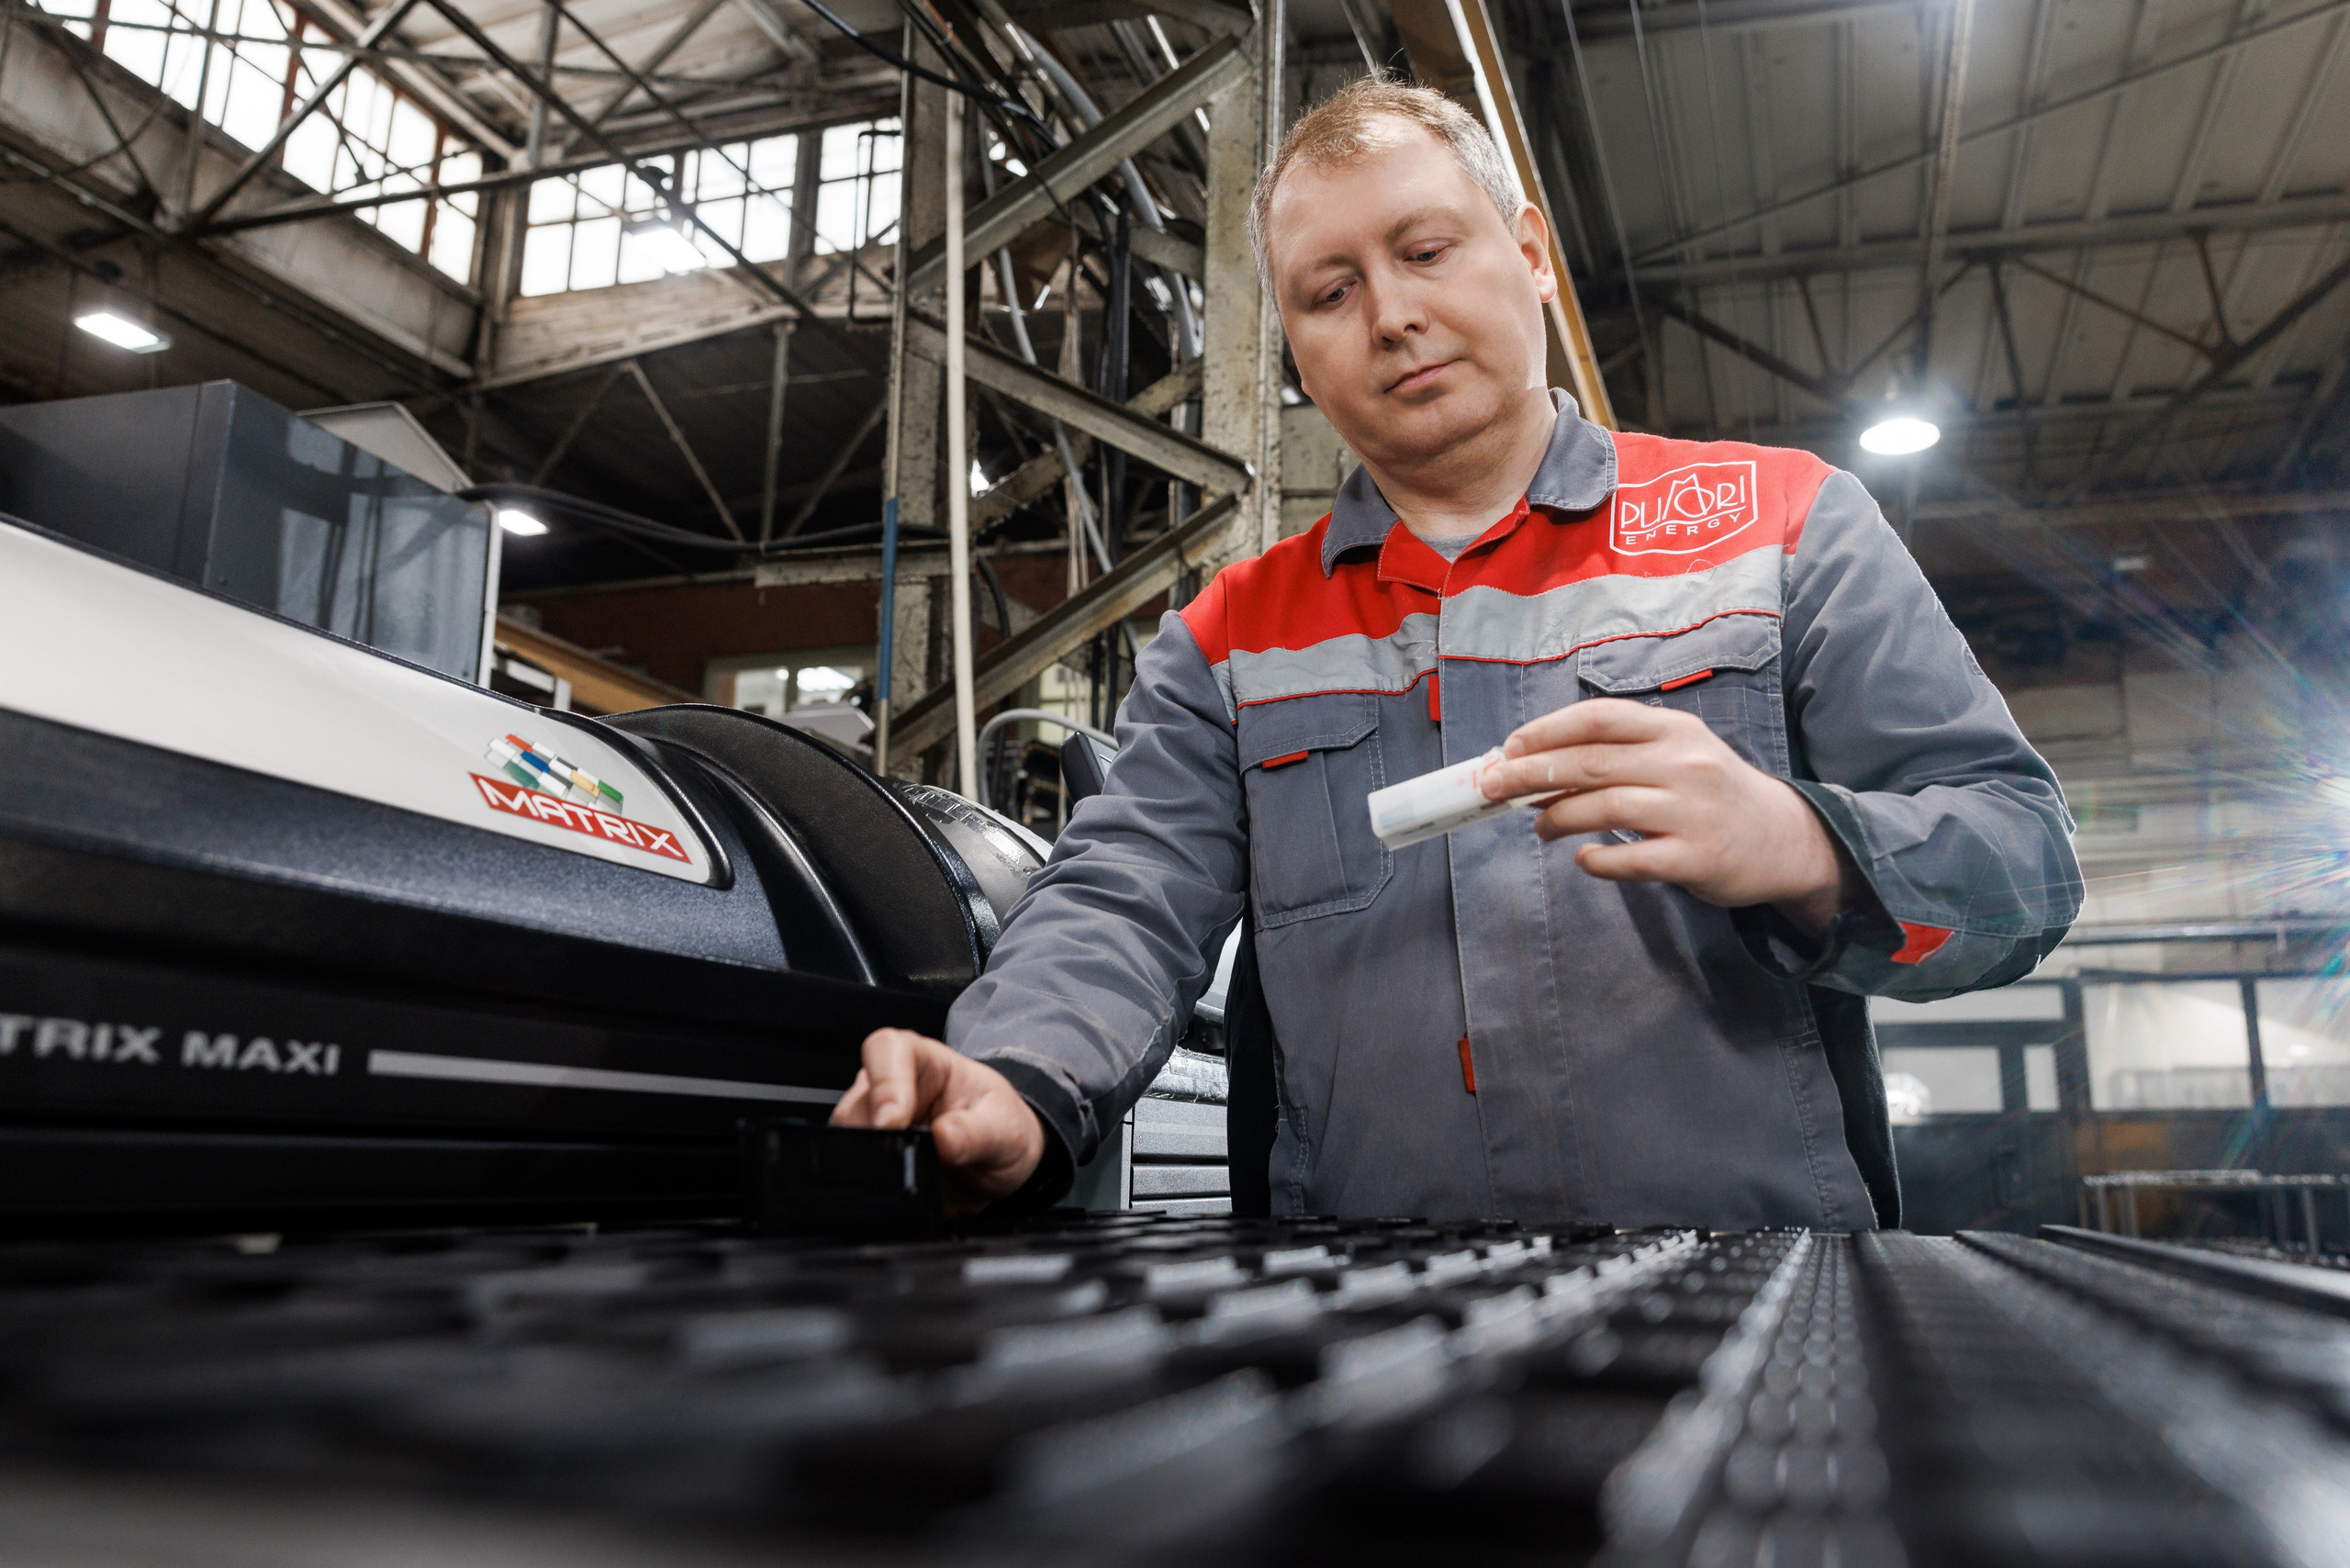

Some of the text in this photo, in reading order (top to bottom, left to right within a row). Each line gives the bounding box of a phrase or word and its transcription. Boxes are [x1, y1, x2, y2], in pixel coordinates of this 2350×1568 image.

[1625, 512, 1740, 544] ENERGY
[477, 778, 683, 857] MATRIX
[182, 1030, 341, 1076] MAXI
